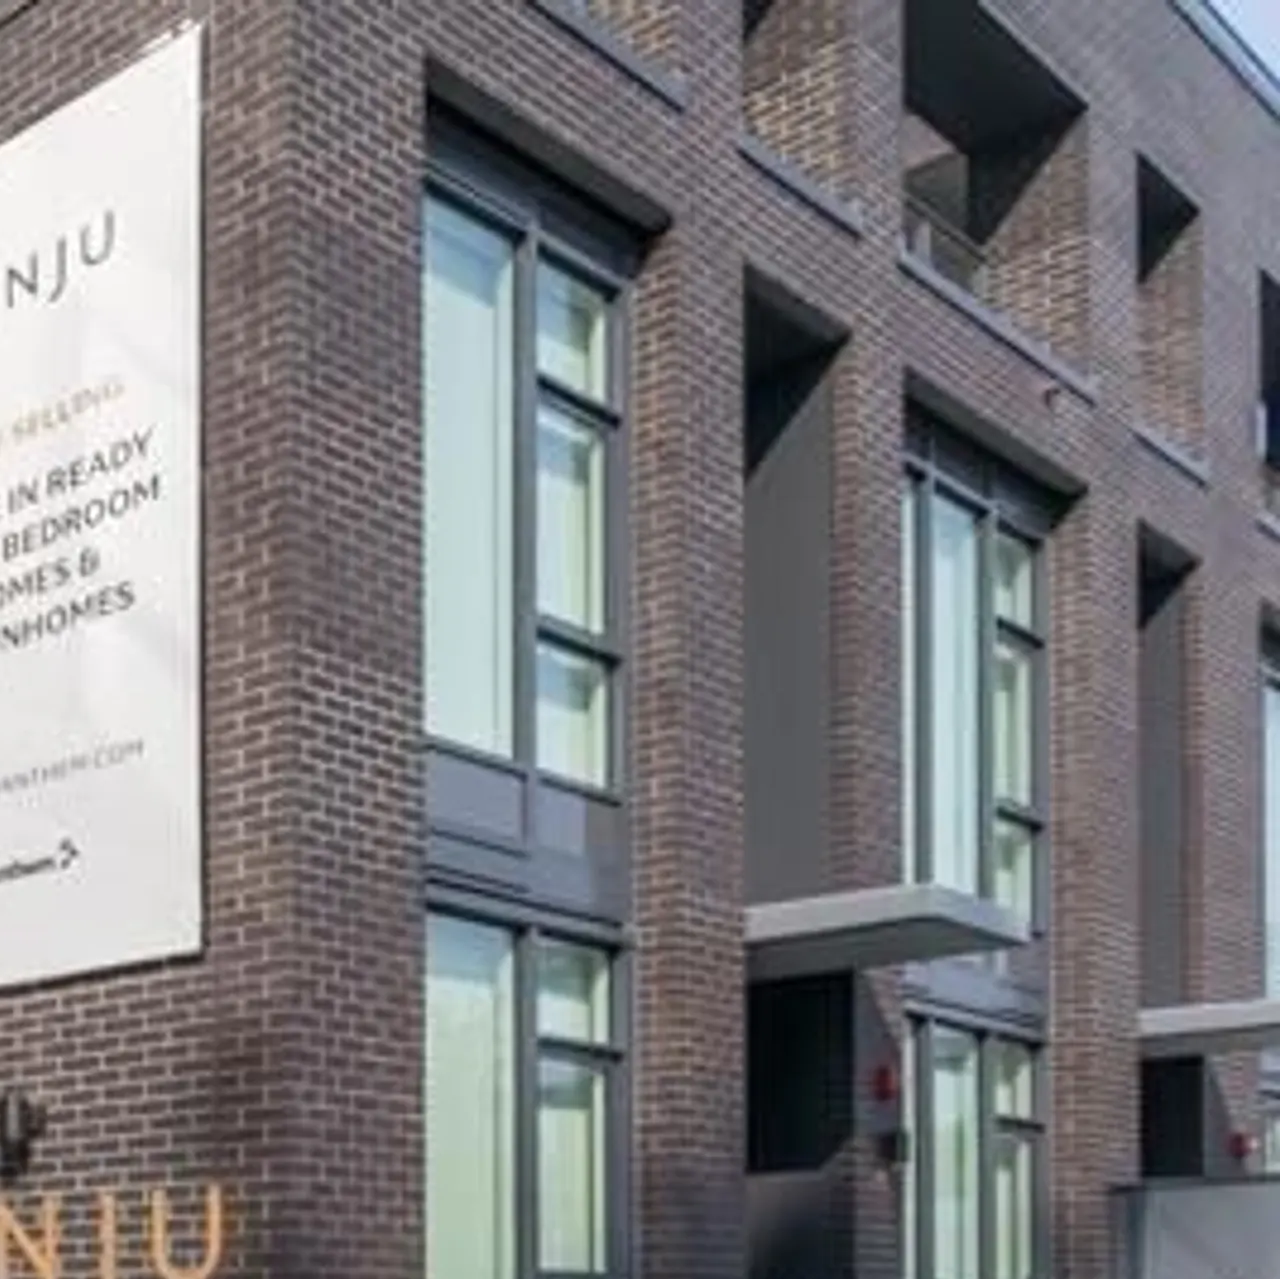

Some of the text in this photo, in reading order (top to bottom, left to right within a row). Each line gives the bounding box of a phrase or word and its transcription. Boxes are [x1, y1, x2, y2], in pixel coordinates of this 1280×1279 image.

[7, 477, 40, 515] IN
[45, 425, 154, 499] READY
[3, 472, 160, 562] BEDROOM
[79, 547, 101, 578] &
